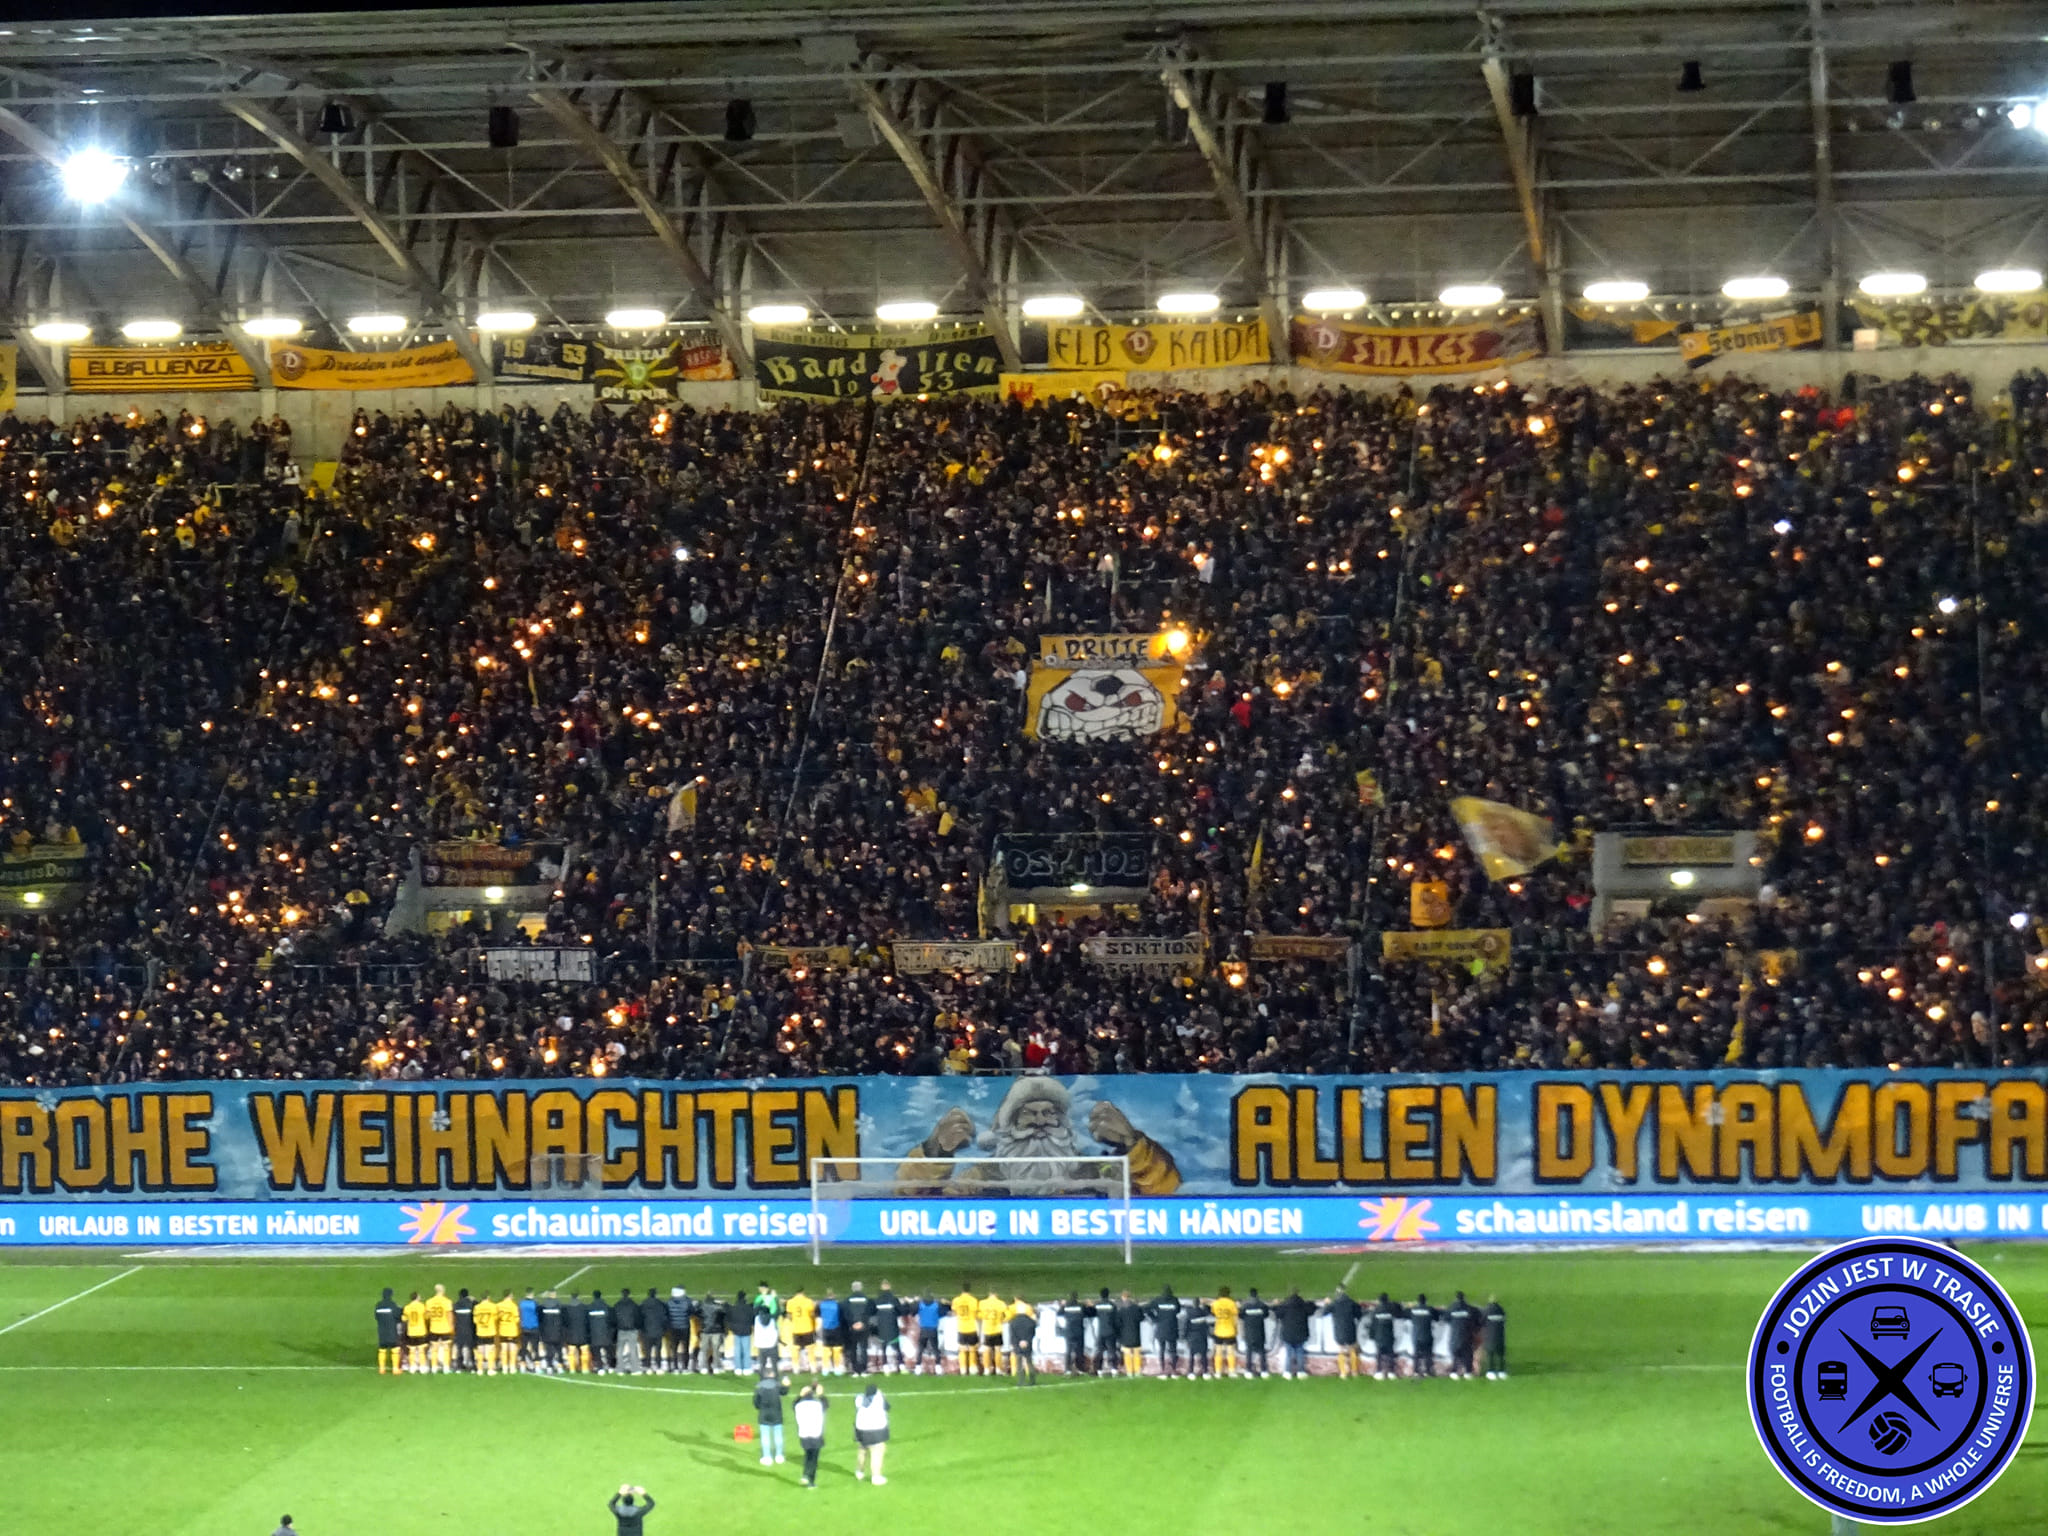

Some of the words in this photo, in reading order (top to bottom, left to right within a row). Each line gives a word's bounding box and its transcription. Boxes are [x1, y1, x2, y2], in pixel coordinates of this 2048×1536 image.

[503, 339, 526, 358] 19
[562, 343, 587, 364] 53
[1055, 328, 1111, 365] ELB
[1170, 322, 1260, 366] KAIDA
[1105, 942, 1200, 955] SEKTION
[0, 1091, 217, 1194] ROHE
[249, 1084, 862, 1191] WEIHNACHTEN
[1232, 1083, 1498, 1186] ALLEN
[39, 1216, 128, 1236] URLAUB
[138, 1216, 160, 1235] IN
[169, 1215, 257, 1235] BESTEN
[267, 1210, 359, 1235] HÄNDEN
[492, 1207, 713, 1238] schauinsland
[725, 1205, 828, 1236] reisen
[880, 1209, 997, 1236] URLAUB
[1009, 1210, 1039, 1235] IN
[1052, 1209, 1167, 1235] BESTEN
[1180, 1203, 1302, 1235] HÄNDEN
[1456, 1201, 1688, 1234] schauinsland
[1697, 1200, 1809, 1232] reisen
[1862, 1204, 1987, 1231] URLAUB
[1998, 1203, 2030, 1230] IN
